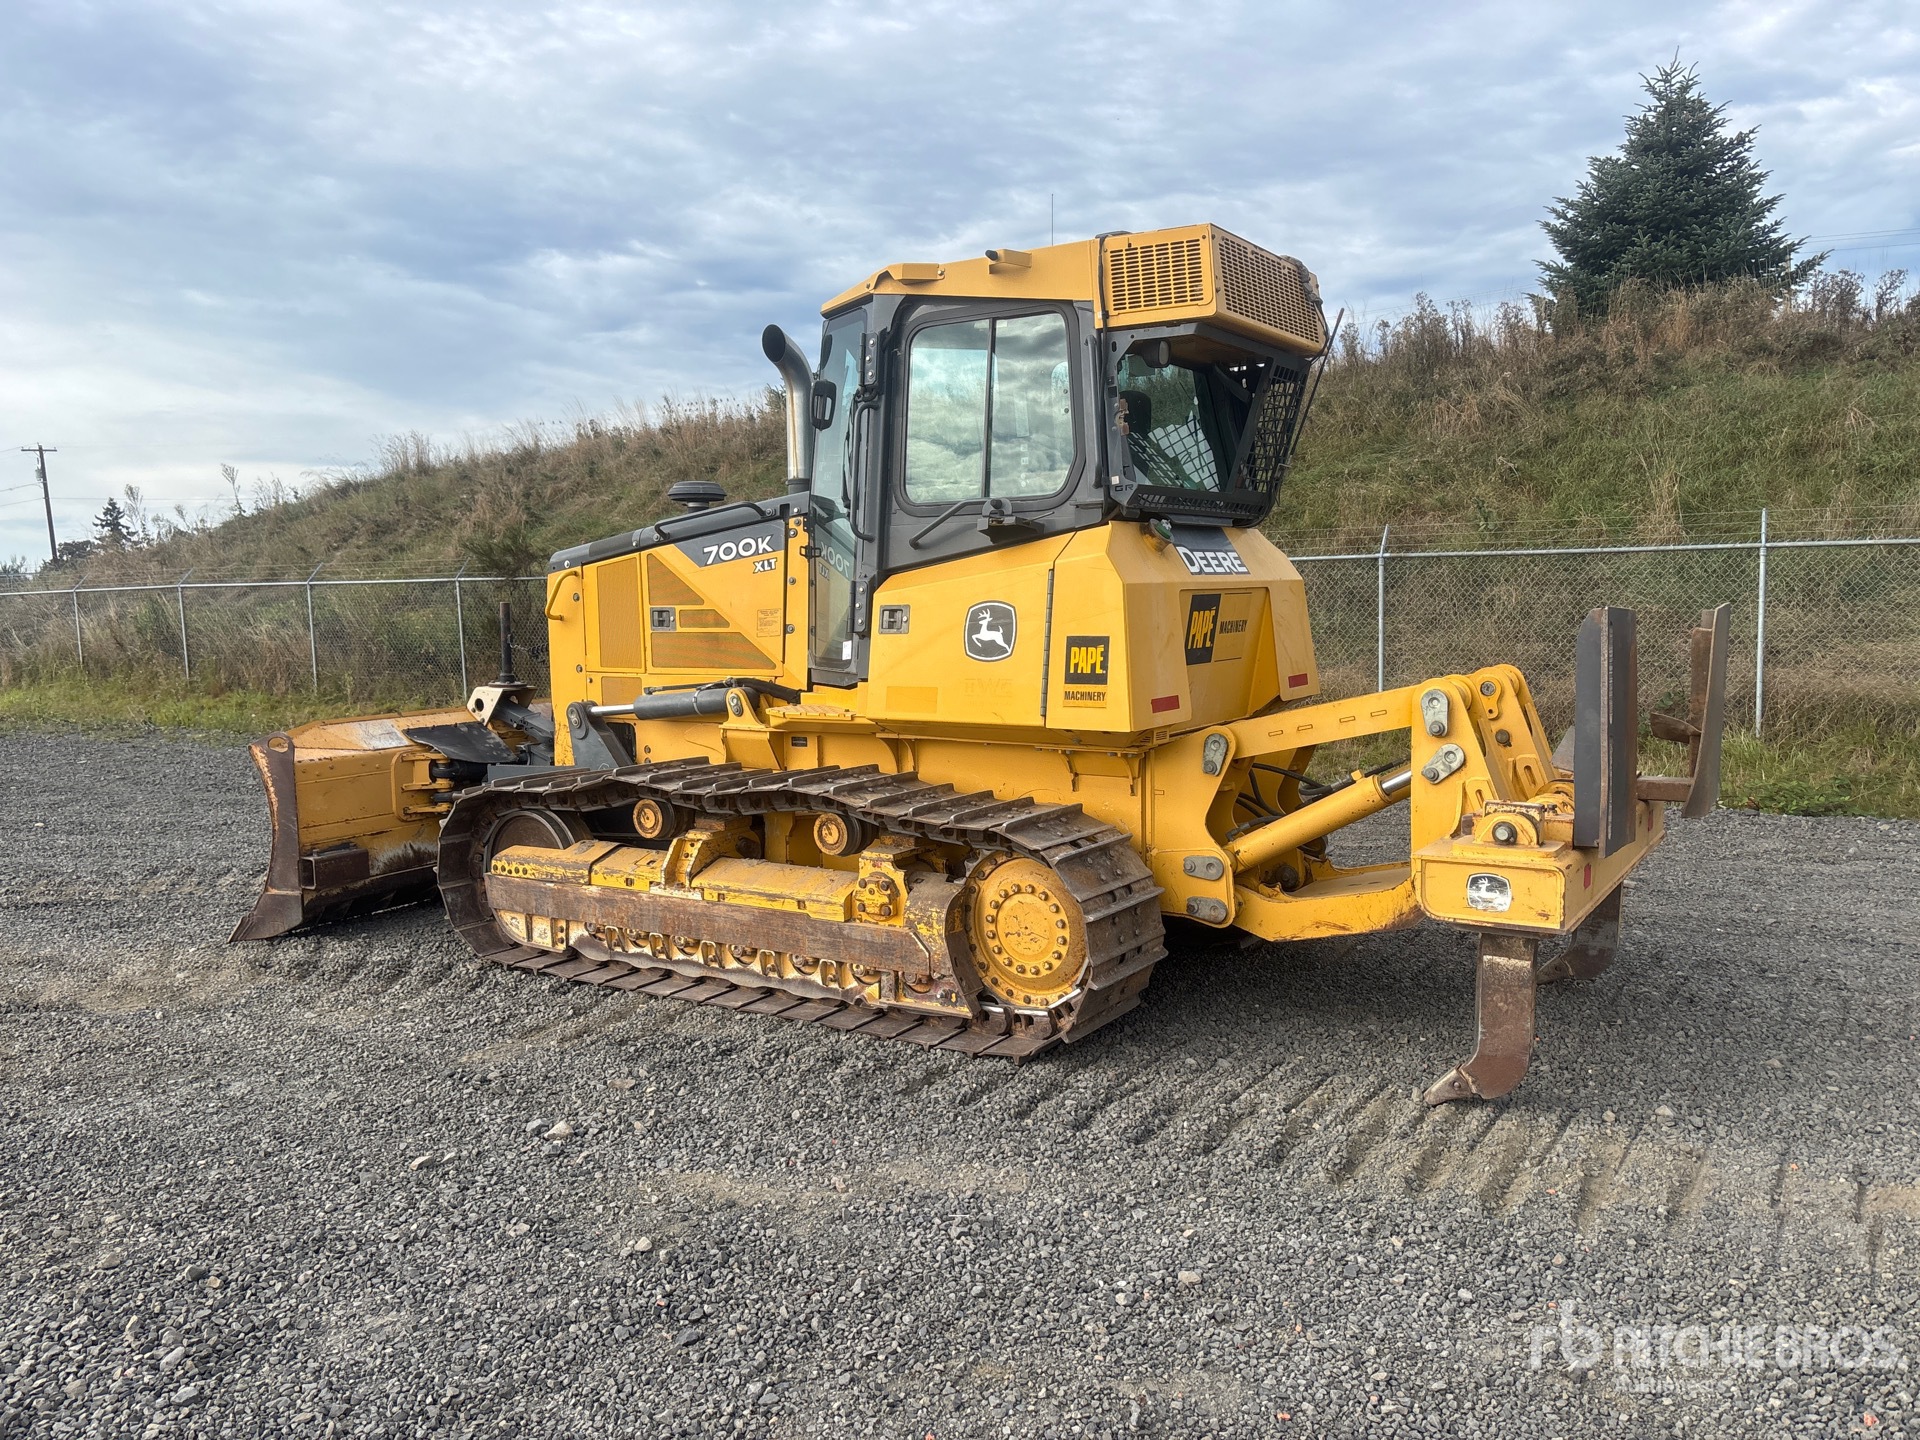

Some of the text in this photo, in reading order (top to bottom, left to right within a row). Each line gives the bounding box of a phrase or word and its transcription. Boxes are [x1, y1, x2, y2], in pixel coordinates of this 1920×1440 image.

[702, 535, 774, 565] 700K
[753, 558, 777, 574] XLT
[1219, 619, 1248, 634] MACHINERY
[1064, 691, 1106, 702] MACHINERY
